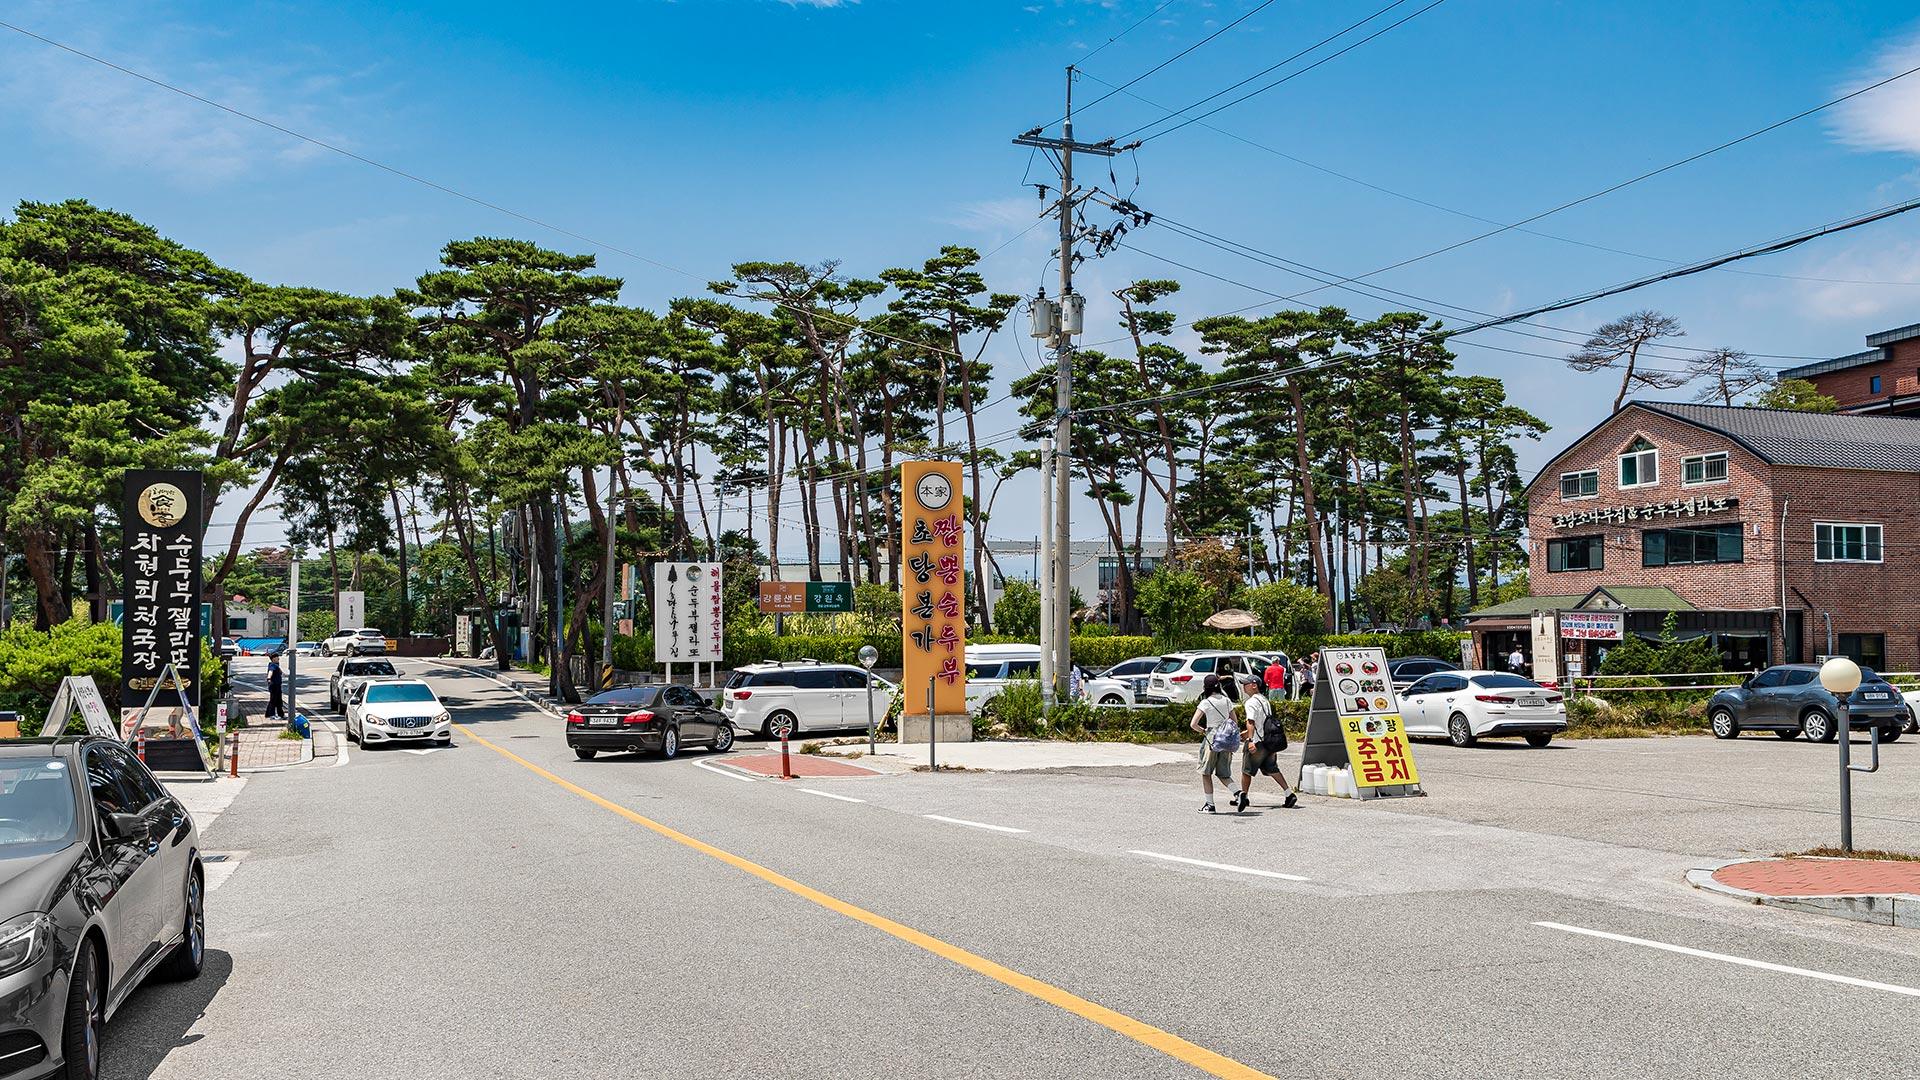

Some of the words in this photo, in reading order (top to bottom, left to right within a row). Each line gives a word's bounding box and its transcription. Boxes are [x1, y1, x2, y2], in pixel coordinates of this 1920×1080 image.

[920, 484, 948, 498] 本家
[166, 533, 193, 670] 순두부젤라또
[687, 584, 700, 657] 순두부젤라또
[908, 517, 936, 653] 초당본가
[932, 513, 962, 686] 짬뽕순두부
[1355, 736, 1404, 760] 주차
[1361, 758, 1411, 783] 금지
